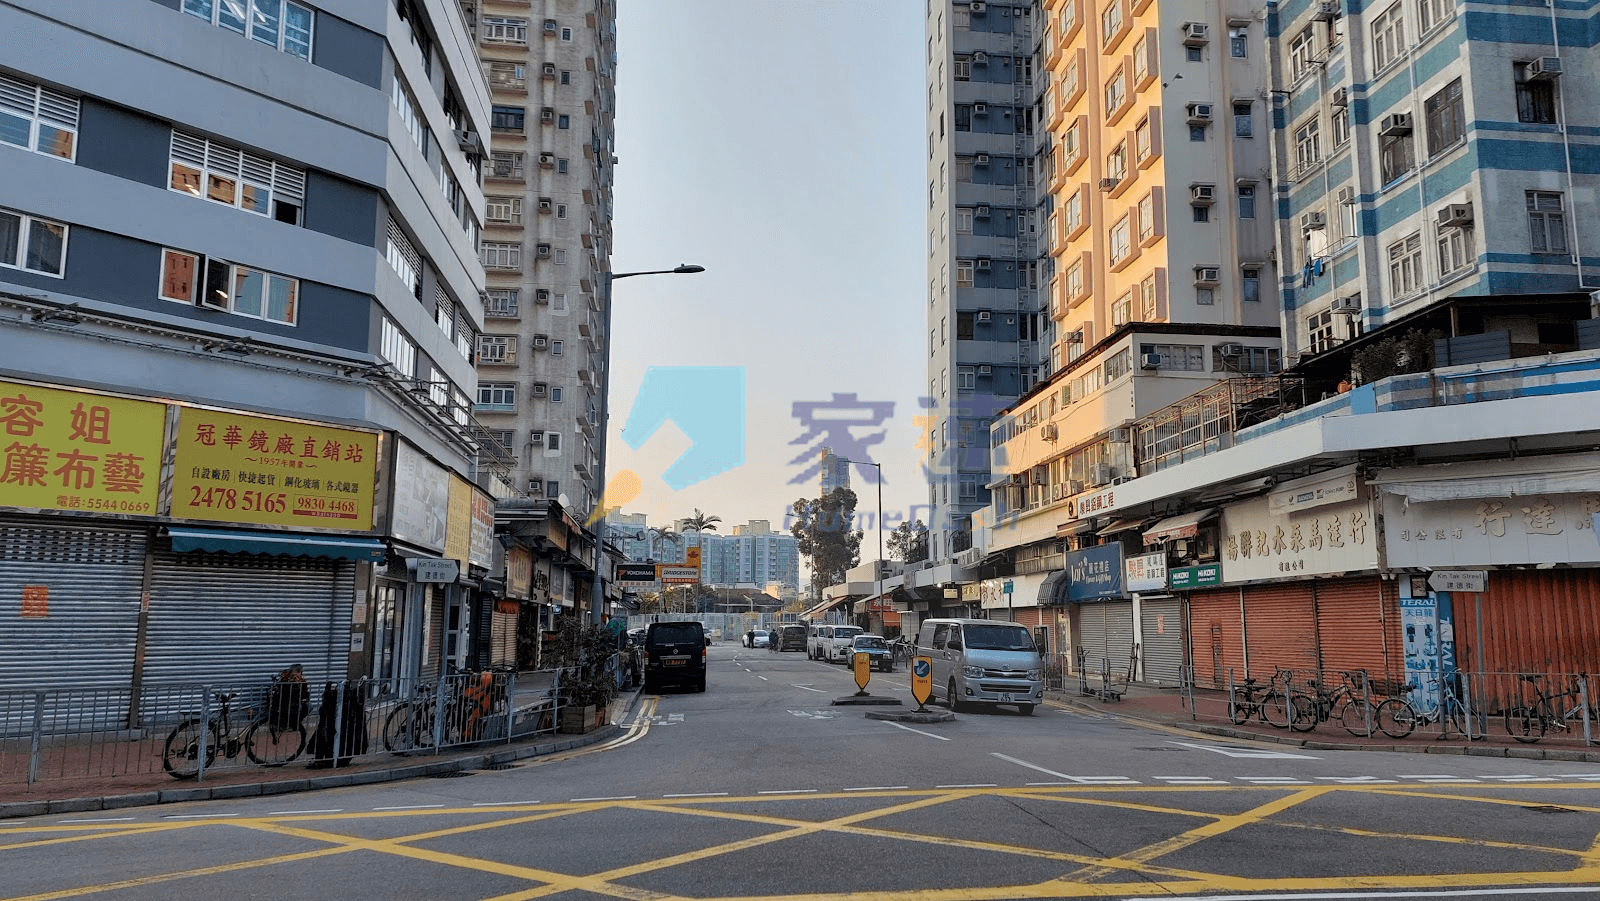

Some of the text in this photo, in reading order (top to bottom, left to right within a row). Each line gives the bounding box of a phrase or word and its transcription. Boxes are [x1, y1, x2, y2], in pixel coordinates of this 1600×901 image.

[0, 393, 111, 444] 容姐
[194, 423, 363, 463] 冠華鏡廠直銷站
[0, 441, 145, 494] 簾布藝
[191, 466, 231, 482] 自設廠房
[238, 470, 276, 487] 快捷起貨
[120, 500, 150, 512] 0669
[189, 485, 287, 514] 2478 5165
[298, 496, 355, 513] 9830 4468
[1401, 599, 1436, 607] TERAL
